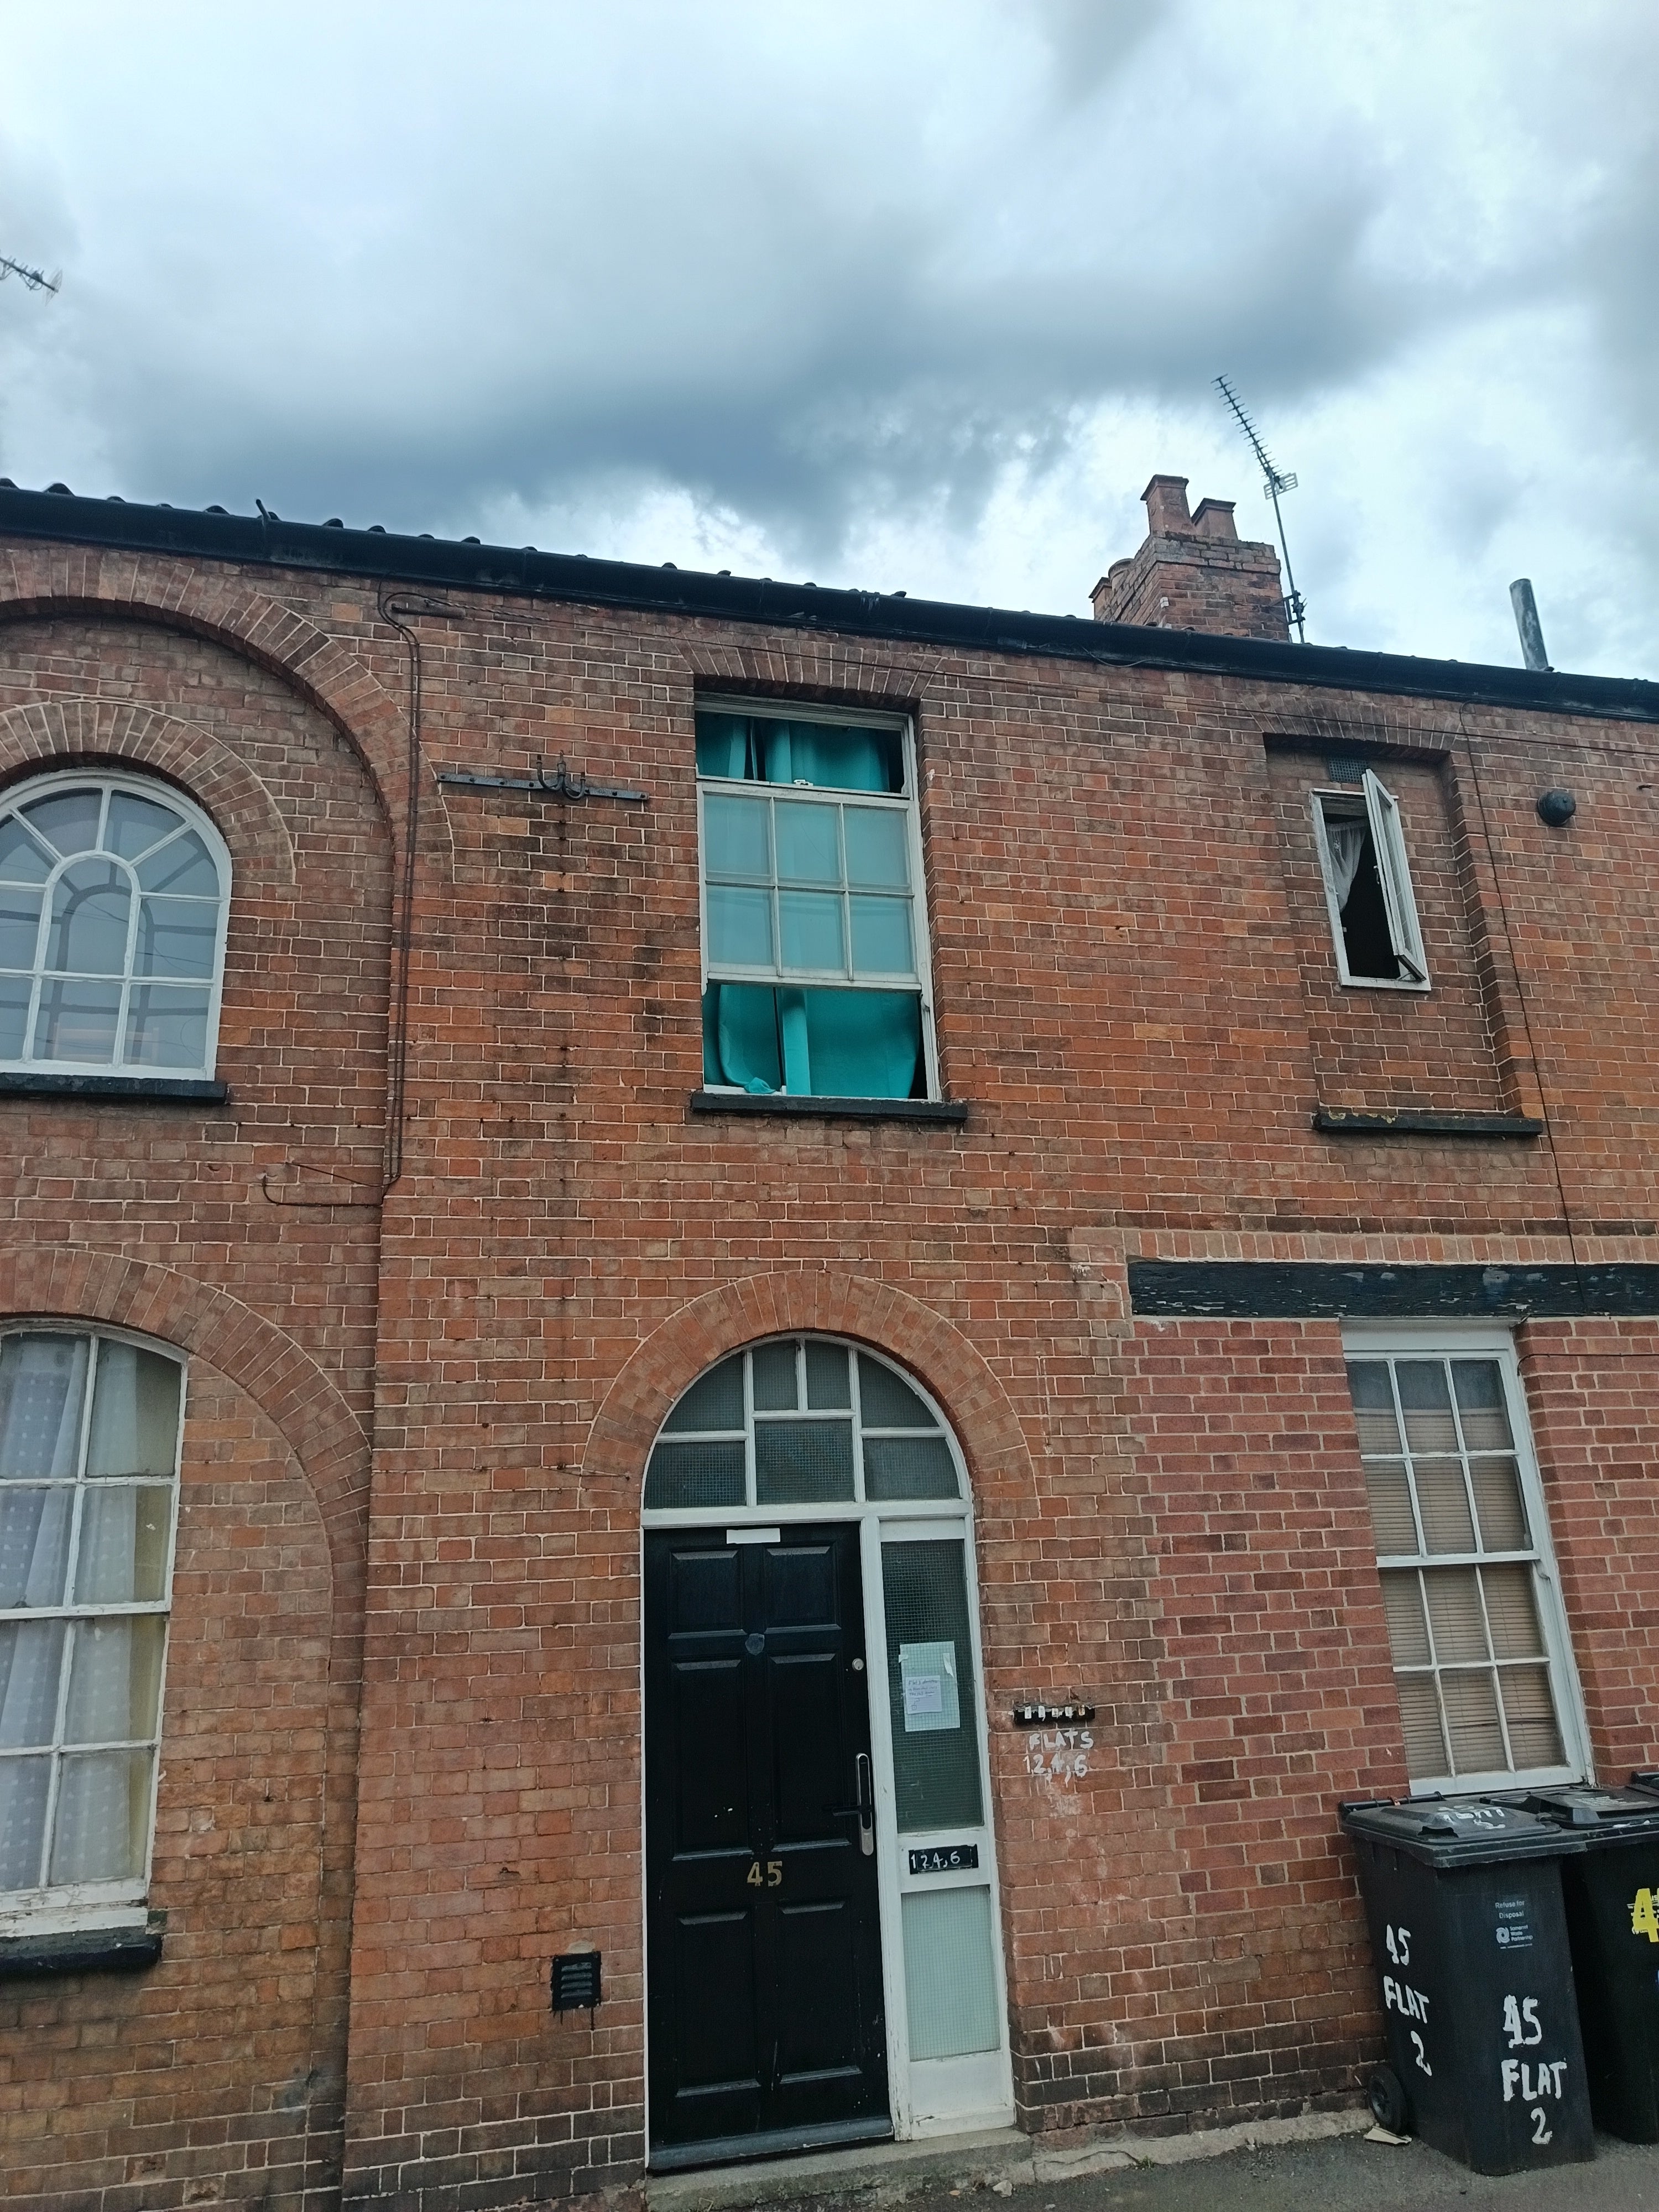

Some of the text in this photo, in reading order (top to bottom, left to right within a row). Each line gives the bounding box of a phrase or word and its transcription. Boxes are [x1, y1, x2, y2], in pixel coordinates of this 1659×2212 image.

[1029, 1729, 1094, 1751] FLATS
[747, 1861, 782, 1887] 45
[1499, 1911, 1525, 1919] Disposal
[1632, 1887, 1659, 1943] 4
[1386, 1924, 1411, 1966] 45
[1383, 1975, 1430, 2024] FLAT
[1503, 1994, 1542, 2048] 45
[1410, 2031, 1432, 2077] 2
[1501, 2058, 1567, 2101] FLAT
[1530, 2106, 1553, 2145] 2
